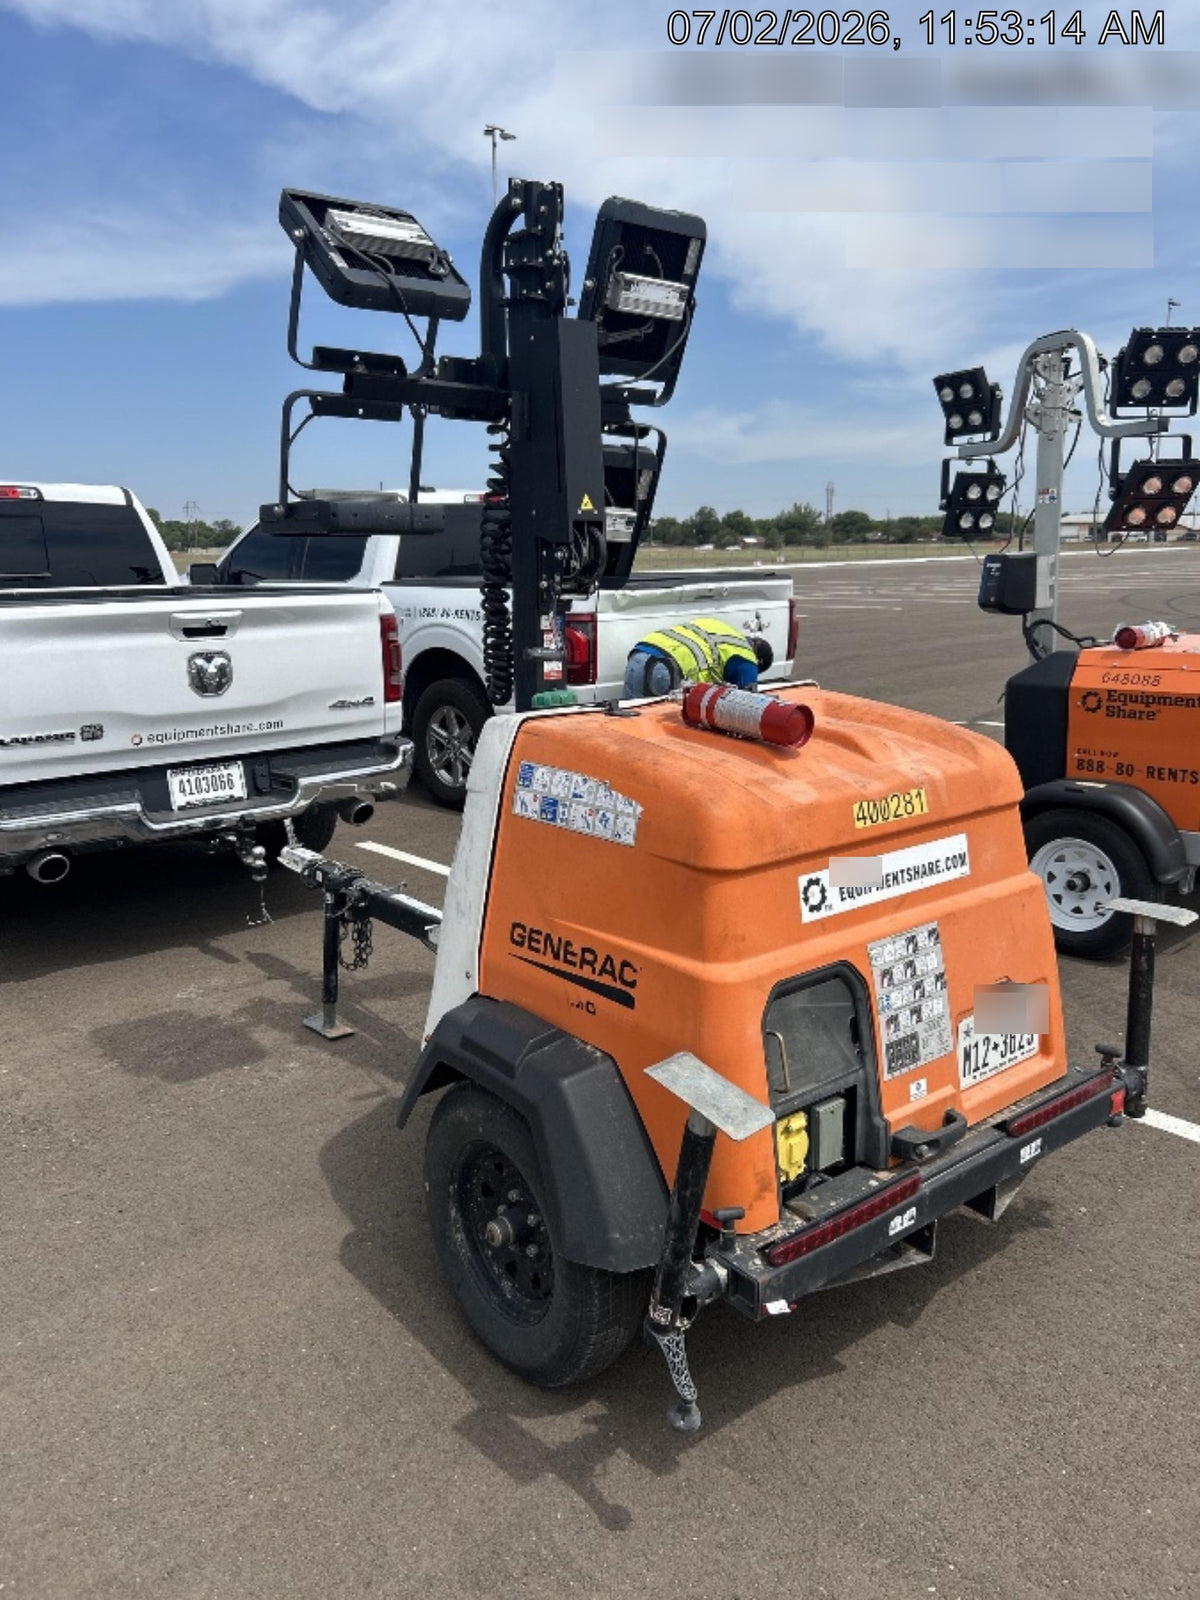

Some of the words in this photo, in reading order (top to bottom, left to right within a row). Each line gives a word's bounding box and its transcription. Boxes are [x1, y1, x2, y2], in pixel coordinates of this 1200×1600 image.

[1106, 689, 1200, 708] Equipment
[1105, 705, 1157, 720] Share
[146, 719, 284, 744] equipmentshare.com
[856, 789, 925, 826] 400281
[509, 921, 638, 989] GENERAC
